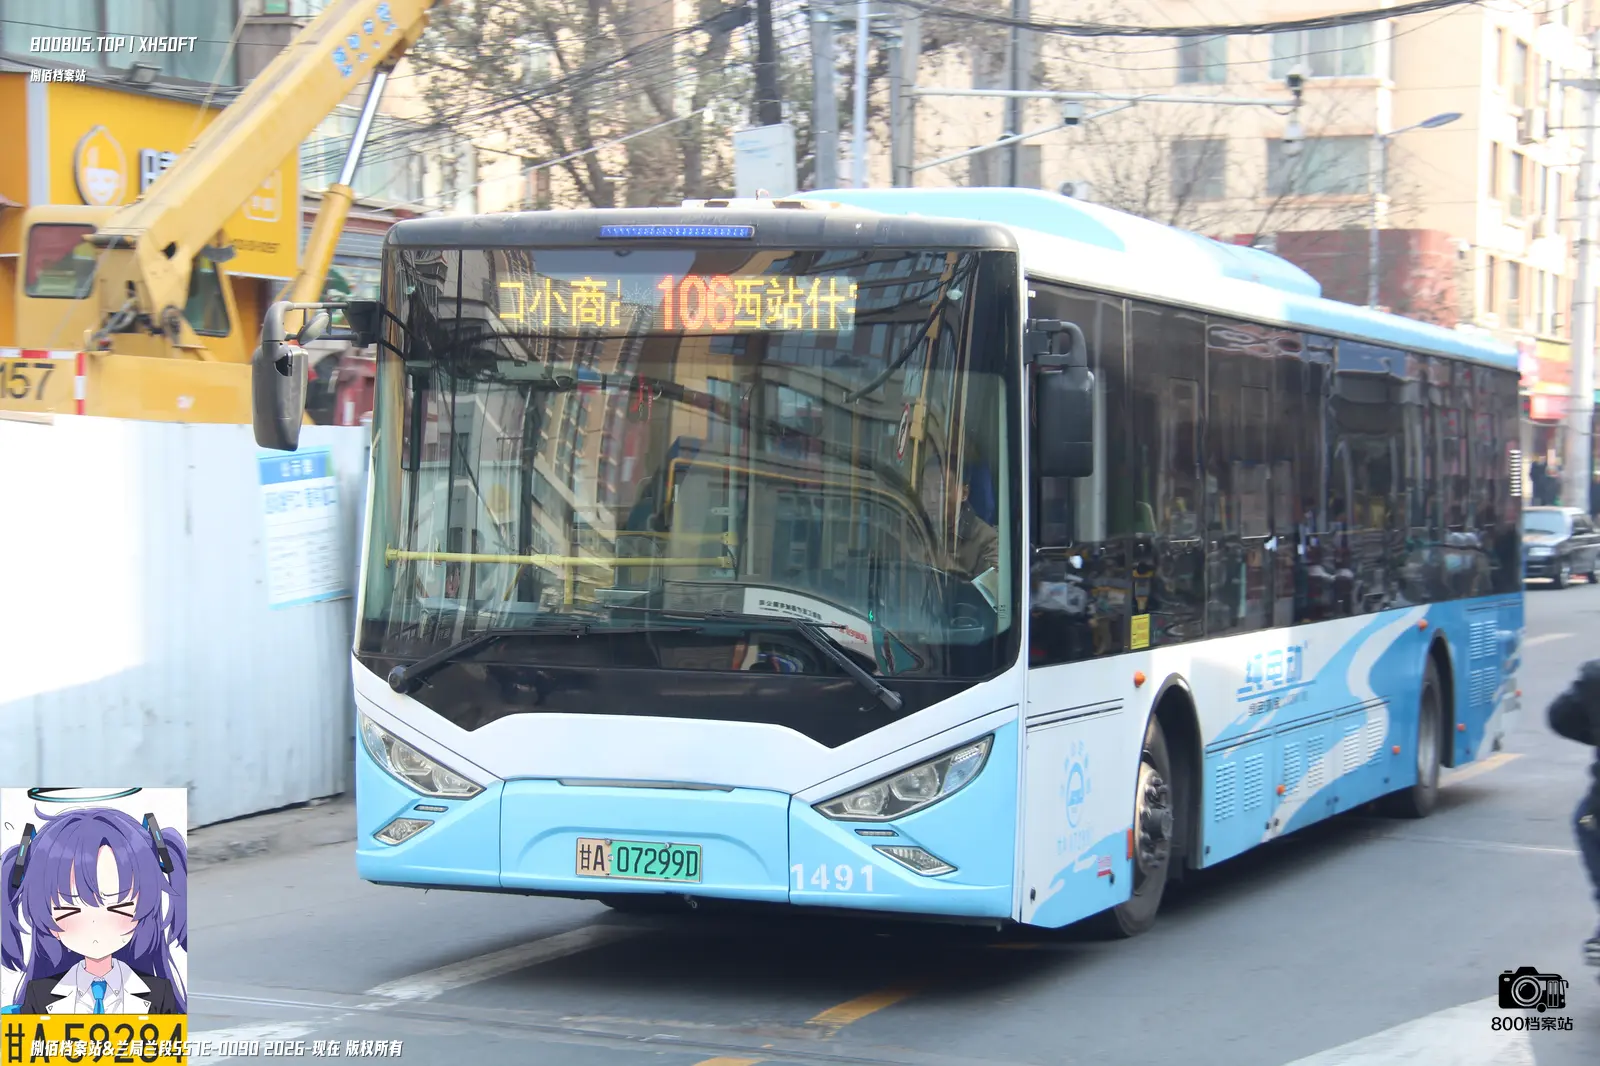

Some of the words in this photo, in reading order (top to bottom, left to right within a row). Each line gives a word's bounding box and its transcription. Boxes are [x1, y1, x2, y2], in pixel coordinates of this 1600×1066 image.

[500, 276, 620, 327] 口小商
[657, 275, 734, 330] 106
[734, 277, 858, 329] 西站什
[617, 846, 699, 877] 07299D
[791, 863, 873, 892] 1491
